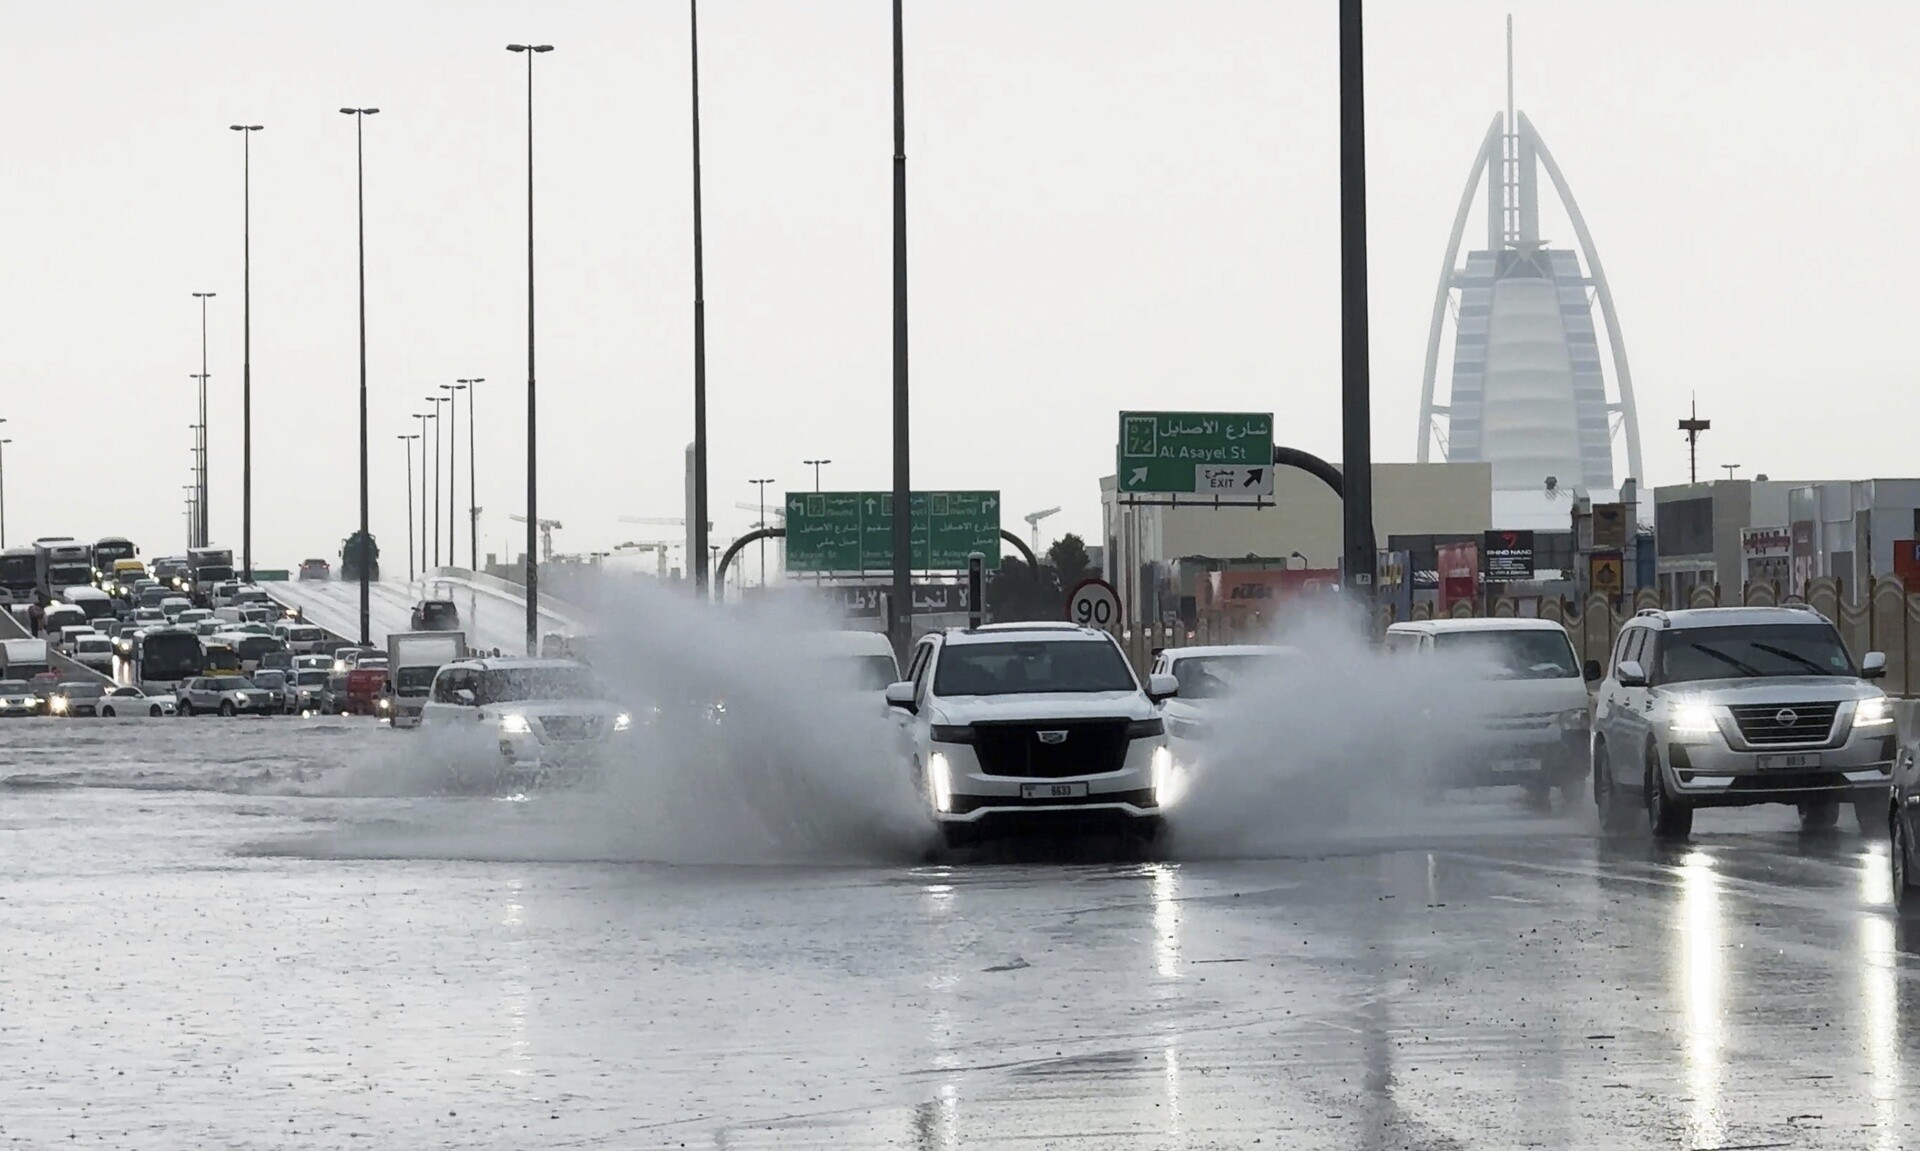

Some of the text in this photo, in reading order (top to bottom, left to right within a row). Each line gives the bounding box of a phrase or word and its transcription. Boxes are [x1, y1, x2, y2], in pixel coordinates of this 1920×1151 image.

[1226, 420, 1268, 440] شارع
[1160, 446, 1247, 461] Al Asayel St
[1210, 479, 1234, 488] EXIT
[1077, 598, 1111, 624] 90
